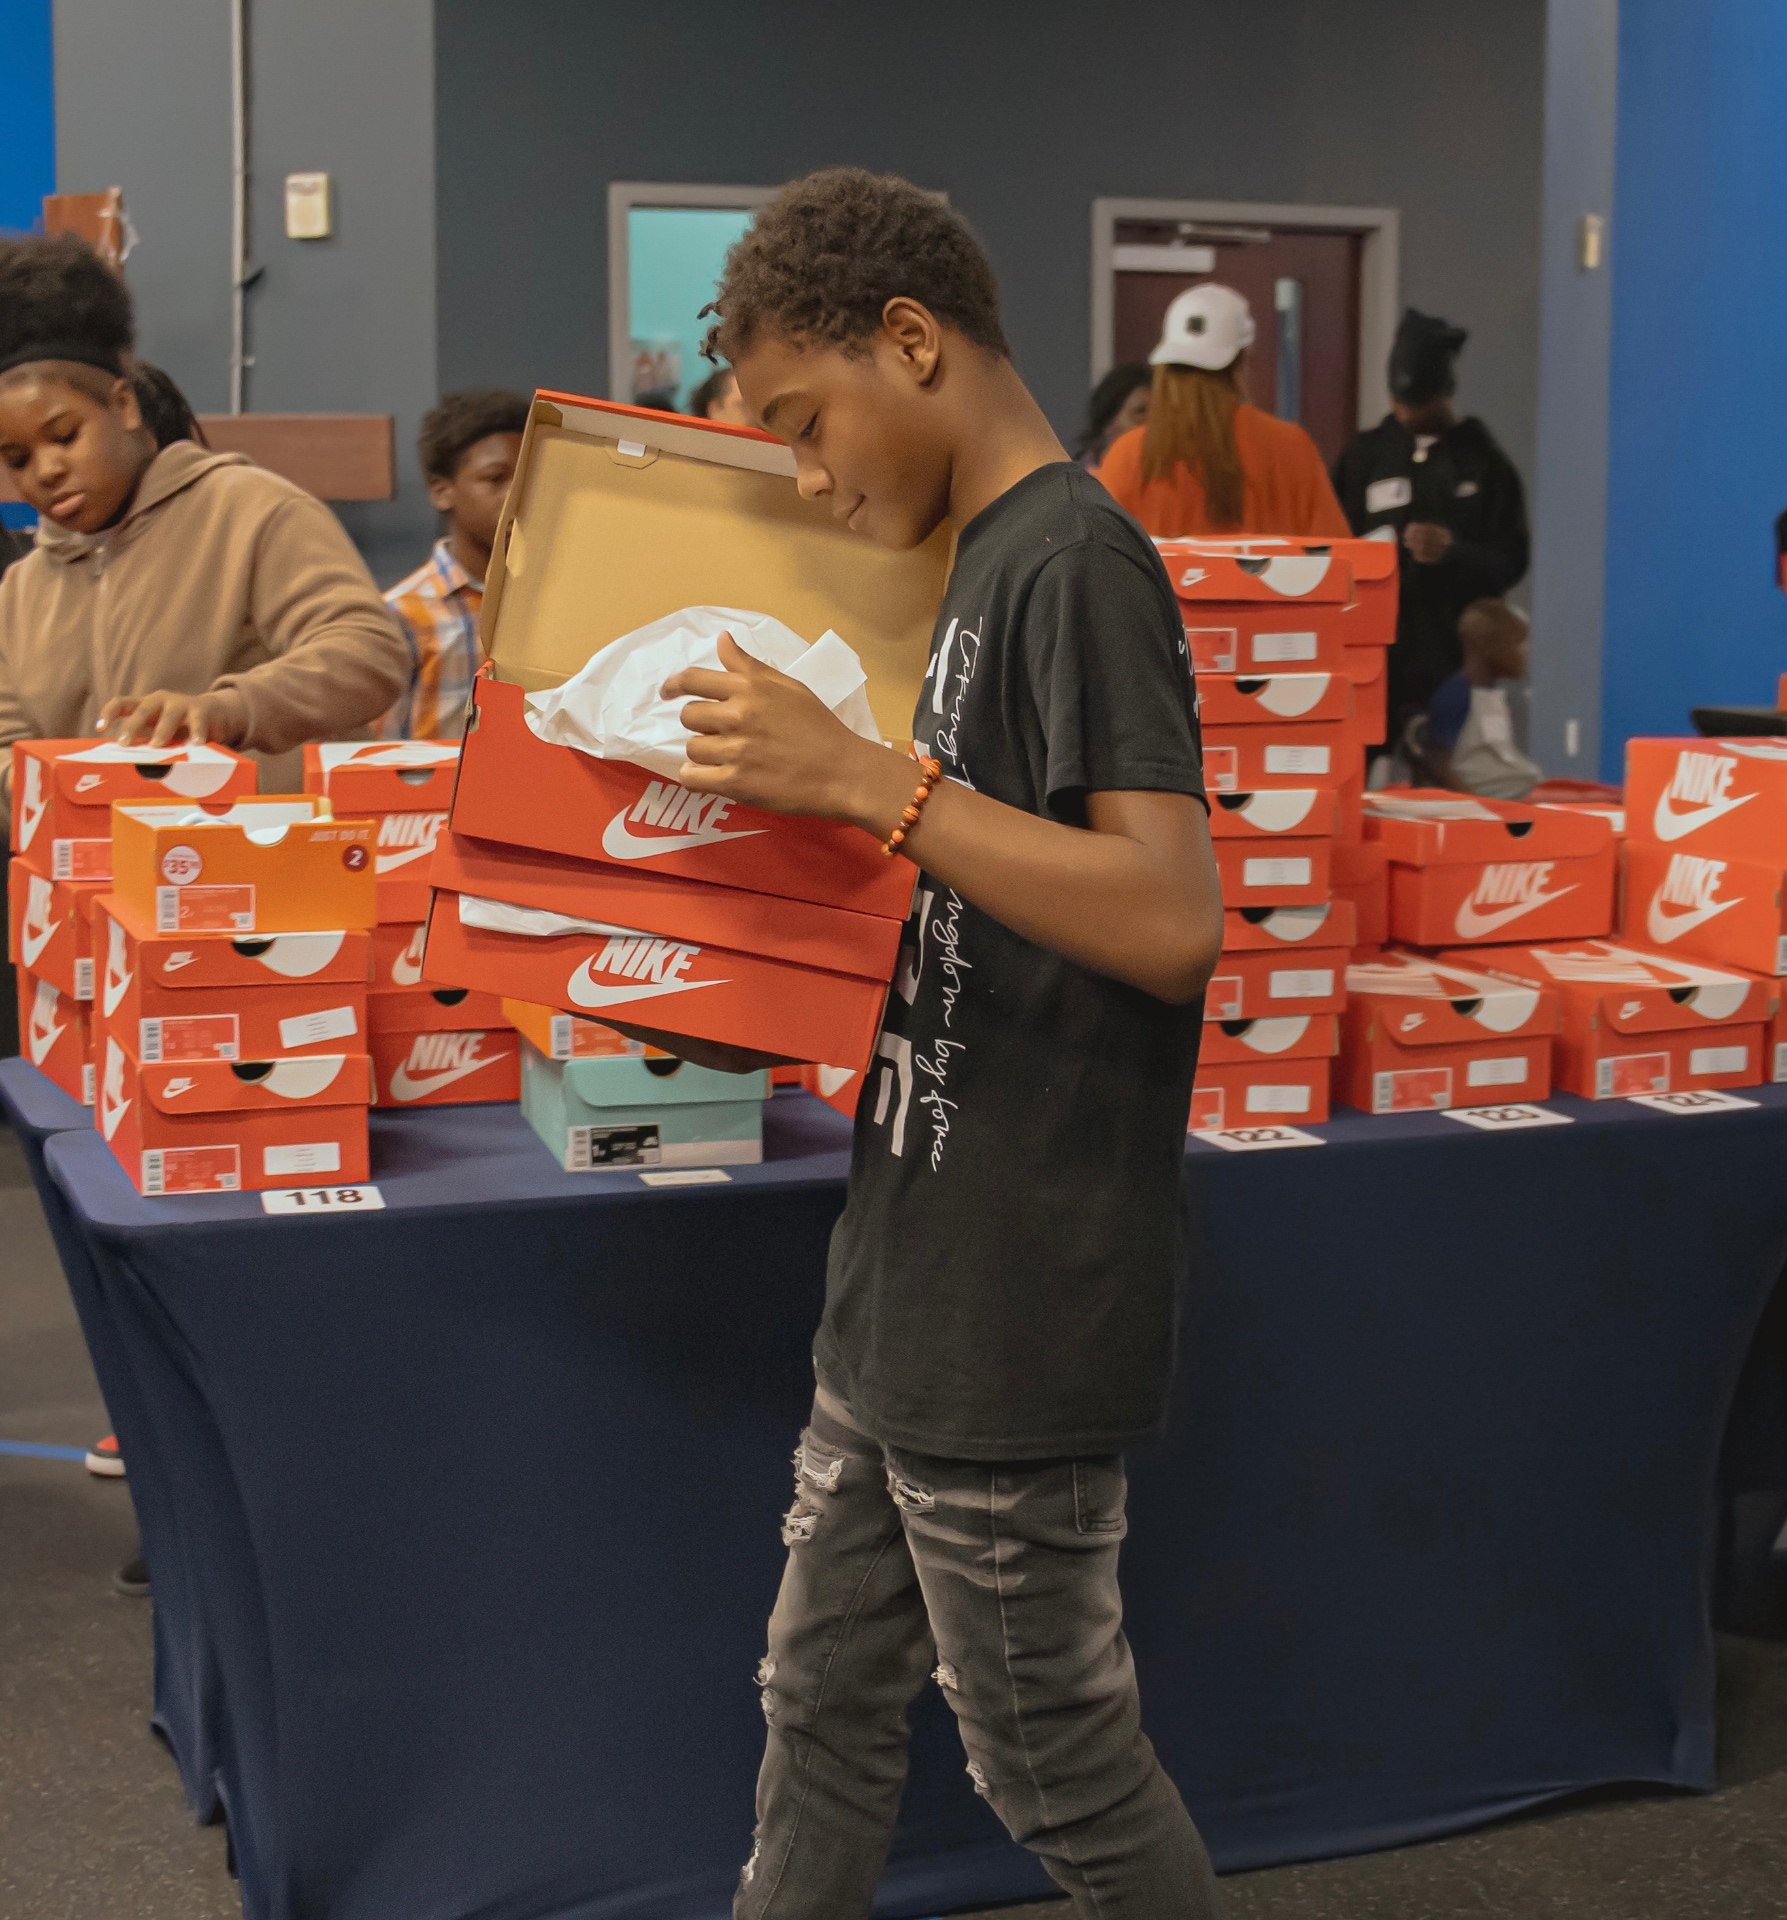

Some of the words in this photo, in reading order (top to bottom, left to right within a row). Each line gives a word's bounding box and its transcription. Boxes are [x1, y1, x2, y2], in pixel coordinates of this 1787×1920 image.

[1670, 750, 1738, 803] NIKE
[377, 813, 449, 847] NIKE
[628, 780, 737, 834] NIKE
[348, 849, 364, 866] 2
[1661, 853, 1728, 909] NIKE
[1474, 861, 1556, 905] NIKE
[592, 934, 702, 984] NIKE
[407, 1033, 485, 1071] NIKE
[915, 1038, 966, 1085] by
[919, 1089, 959, 1172] force
[284, 1189, 364, 1206] 118
